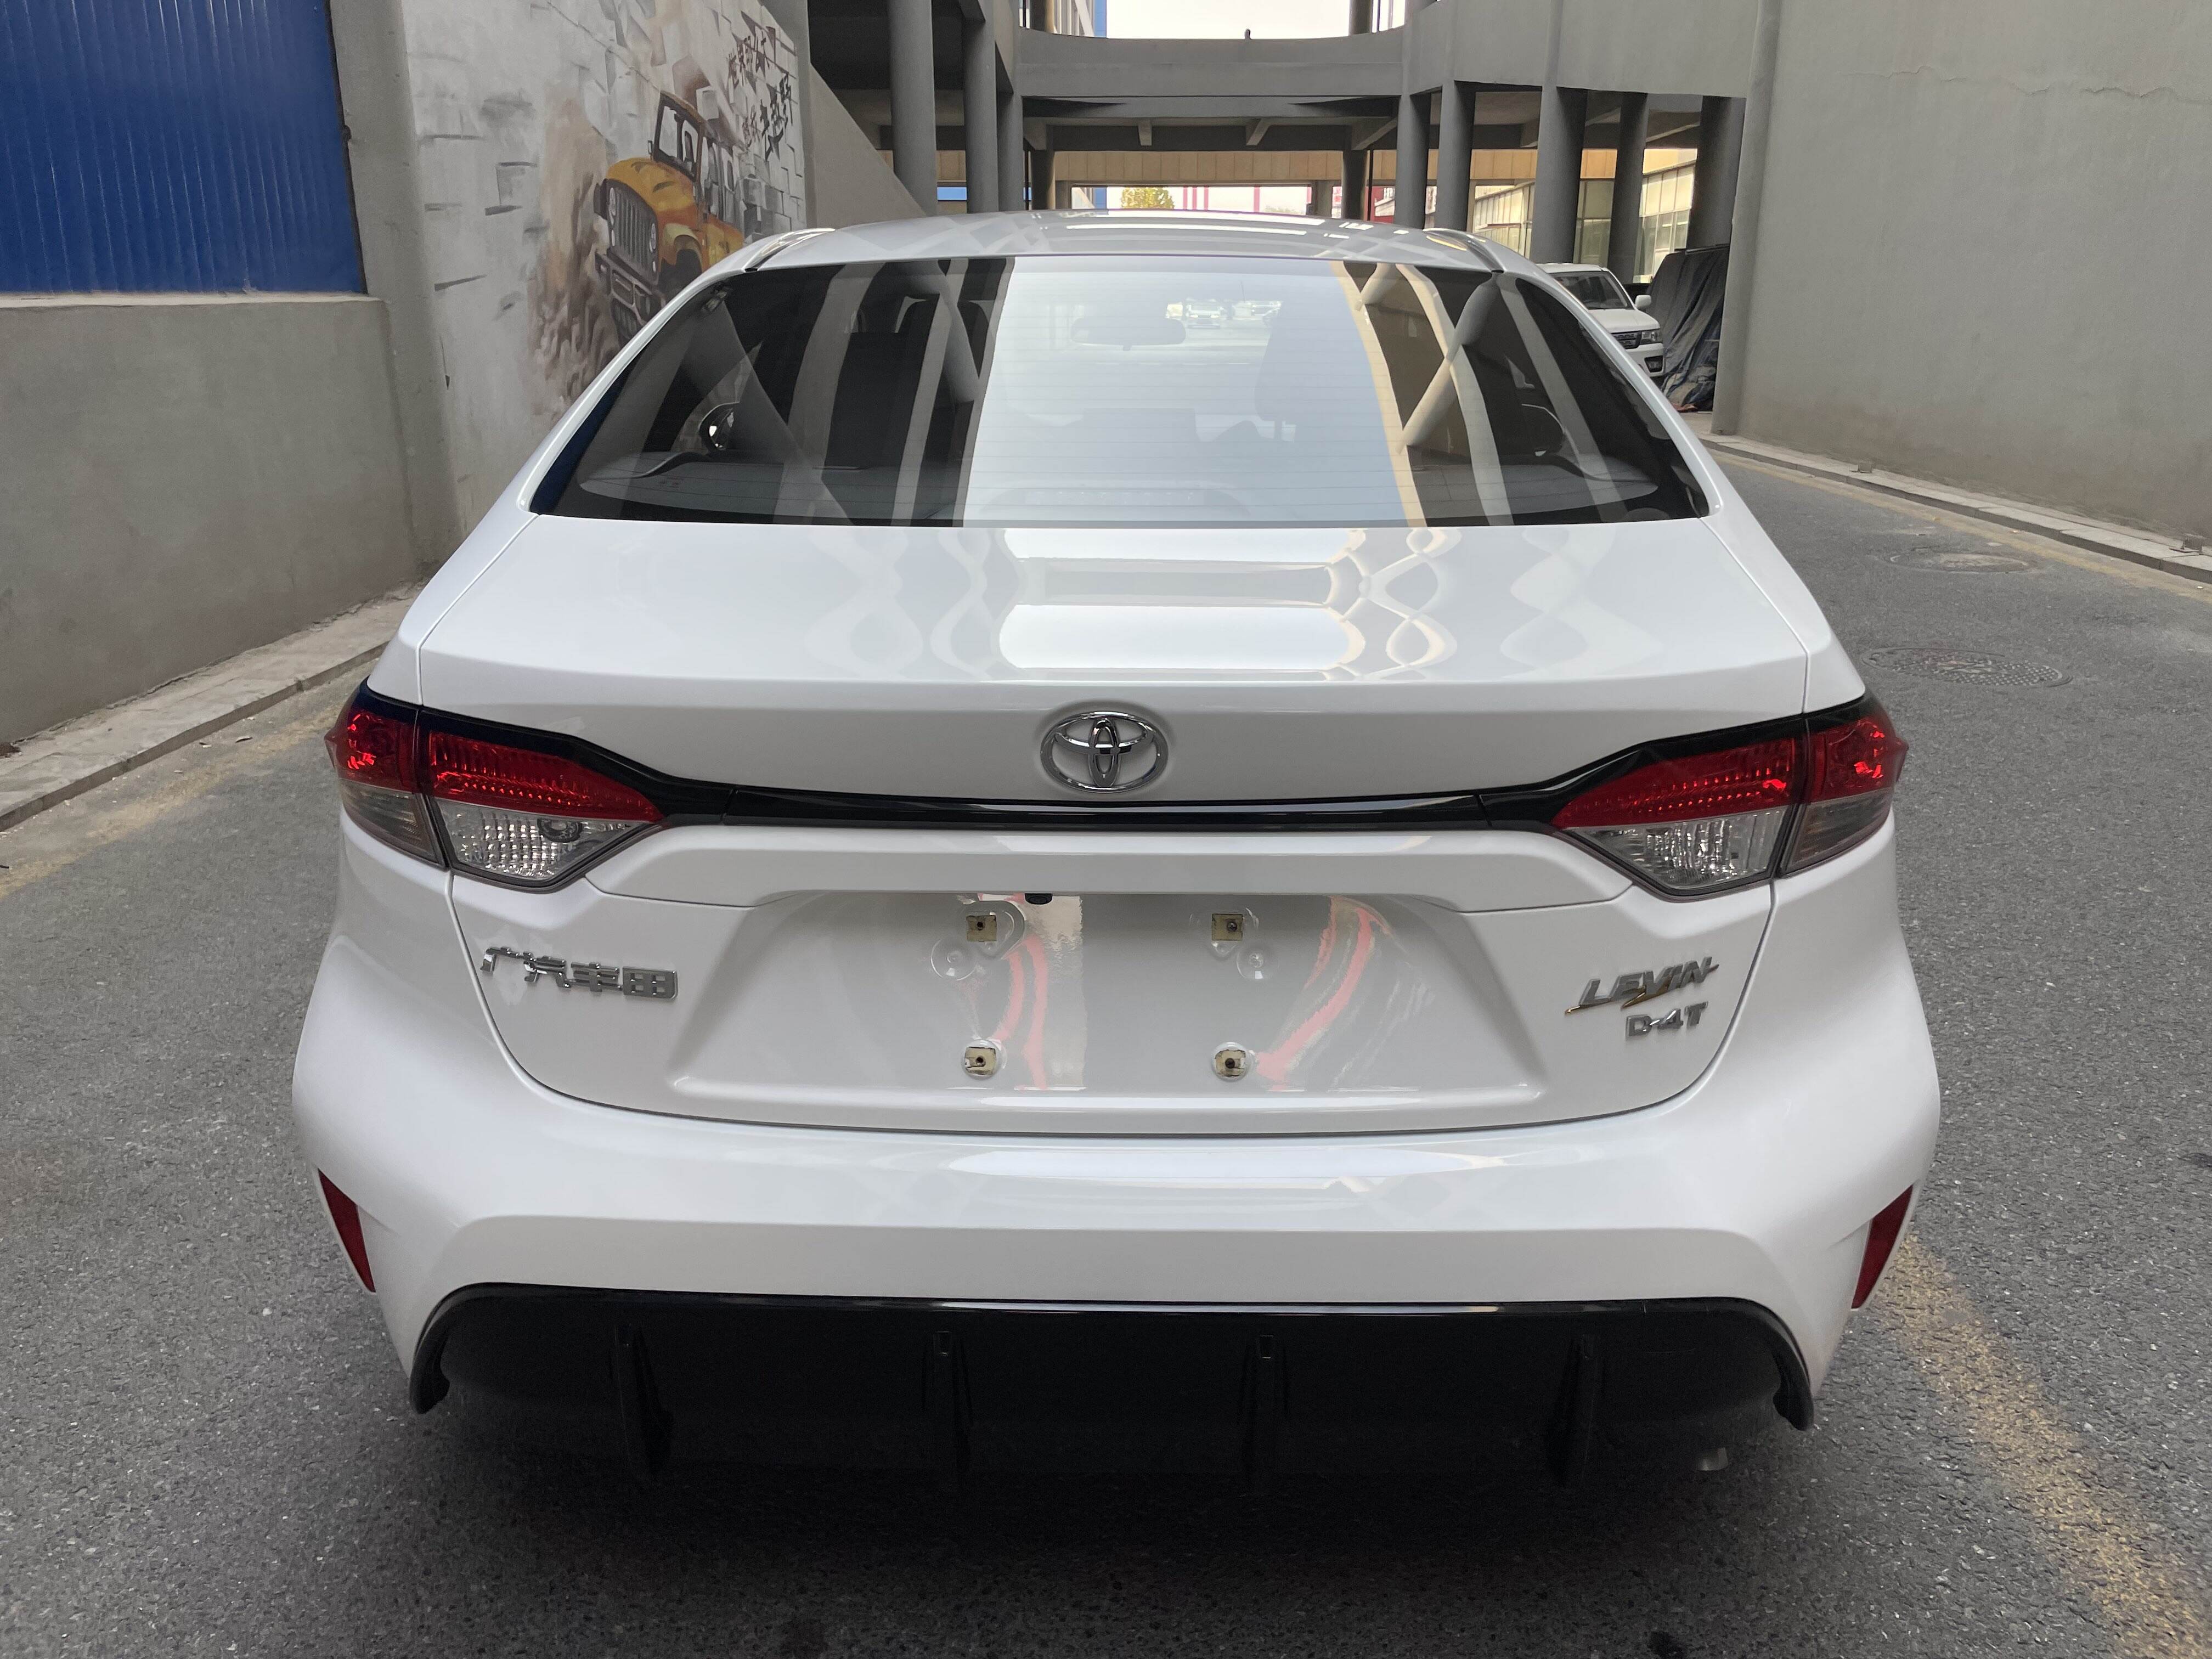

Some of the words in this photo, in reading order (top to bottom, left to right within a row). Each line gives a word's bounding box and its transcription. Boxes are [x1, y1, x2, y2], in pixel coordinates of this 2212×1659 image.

[480, 946, 678, 1000] 广汽丰田
[1568, 957, 1717, 1011] LEVIN
[1626, 1001, 1708, 1037] D-4T
